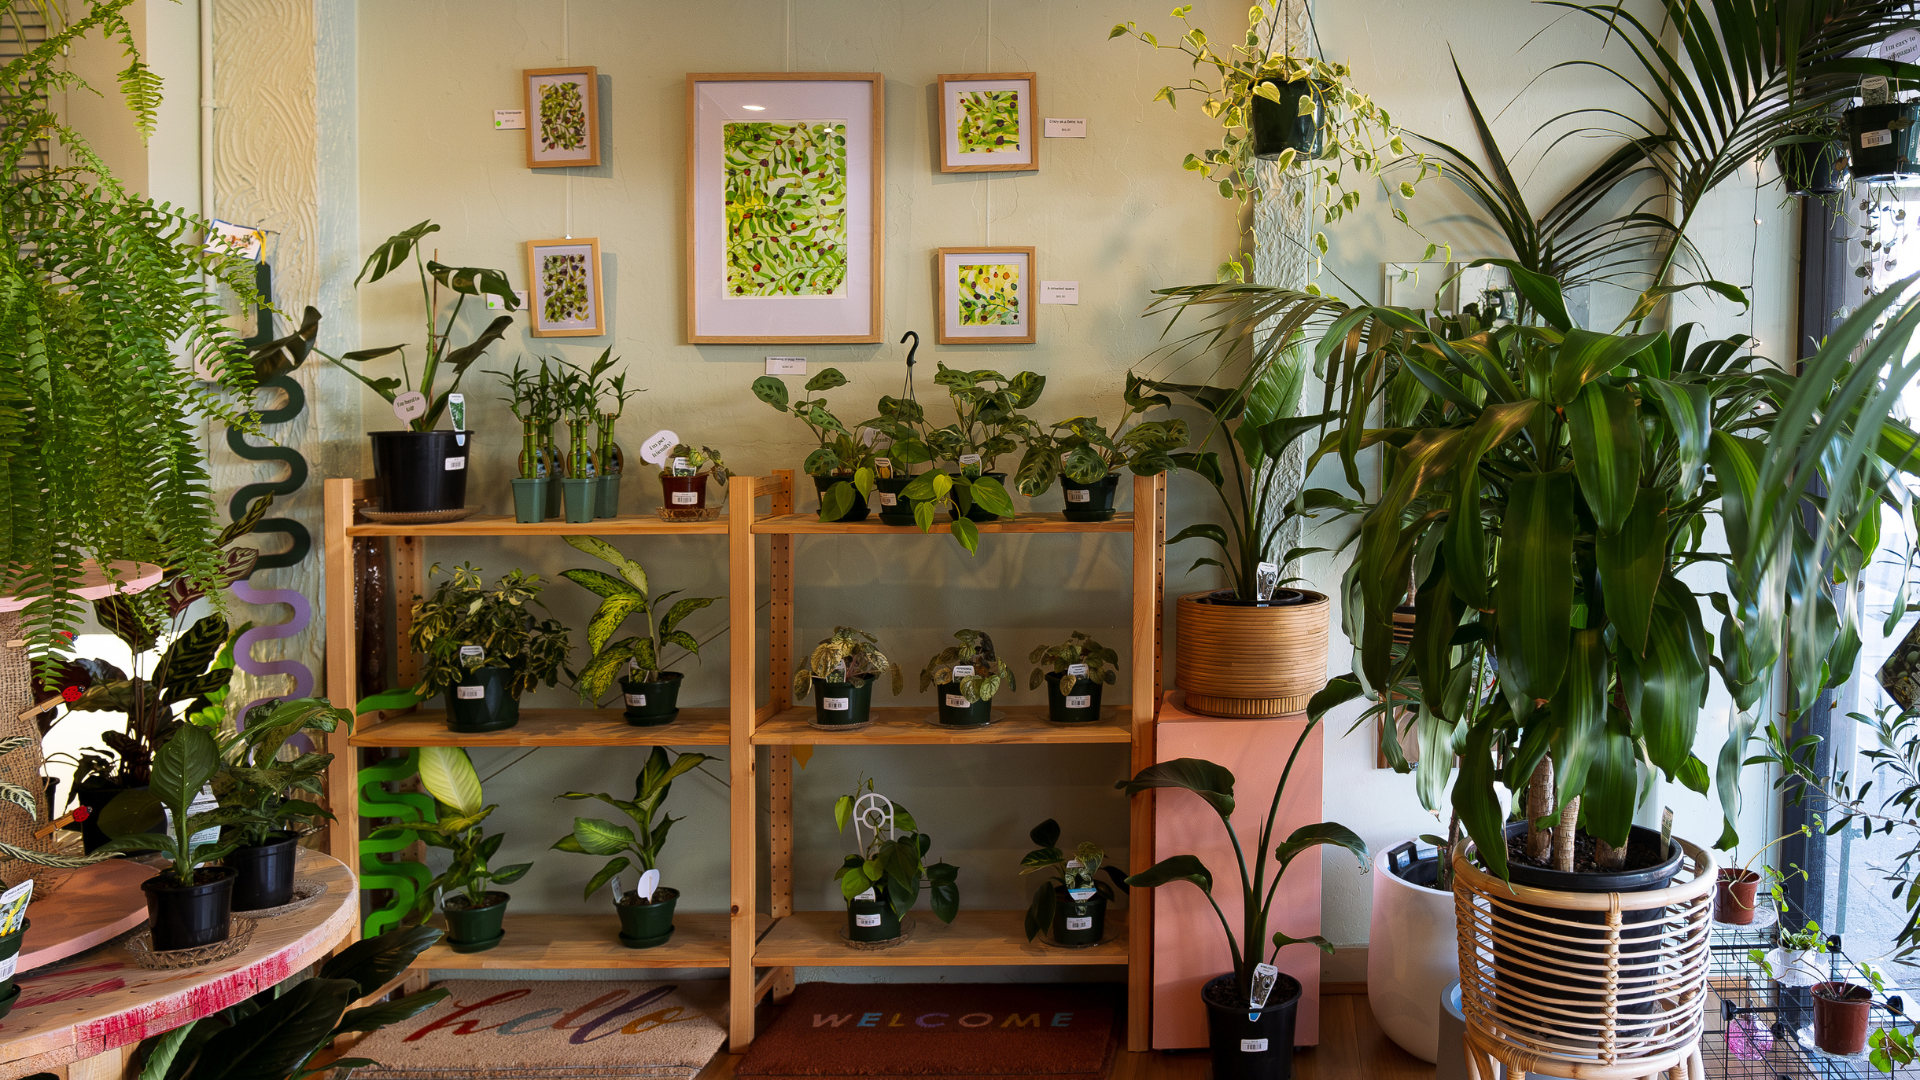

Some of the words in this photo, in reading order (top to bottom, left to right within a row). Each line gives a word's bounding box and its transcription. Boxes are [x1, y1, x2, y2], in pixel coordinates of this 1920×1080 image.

[1895, 39, 1909, 49] easy
[649, 442, 658, 451] I'm
[658, 436, 667, 447] pet
[402, 985, 701, 1045] hello
[812, 1012, 1075, 1028] WELCOME
